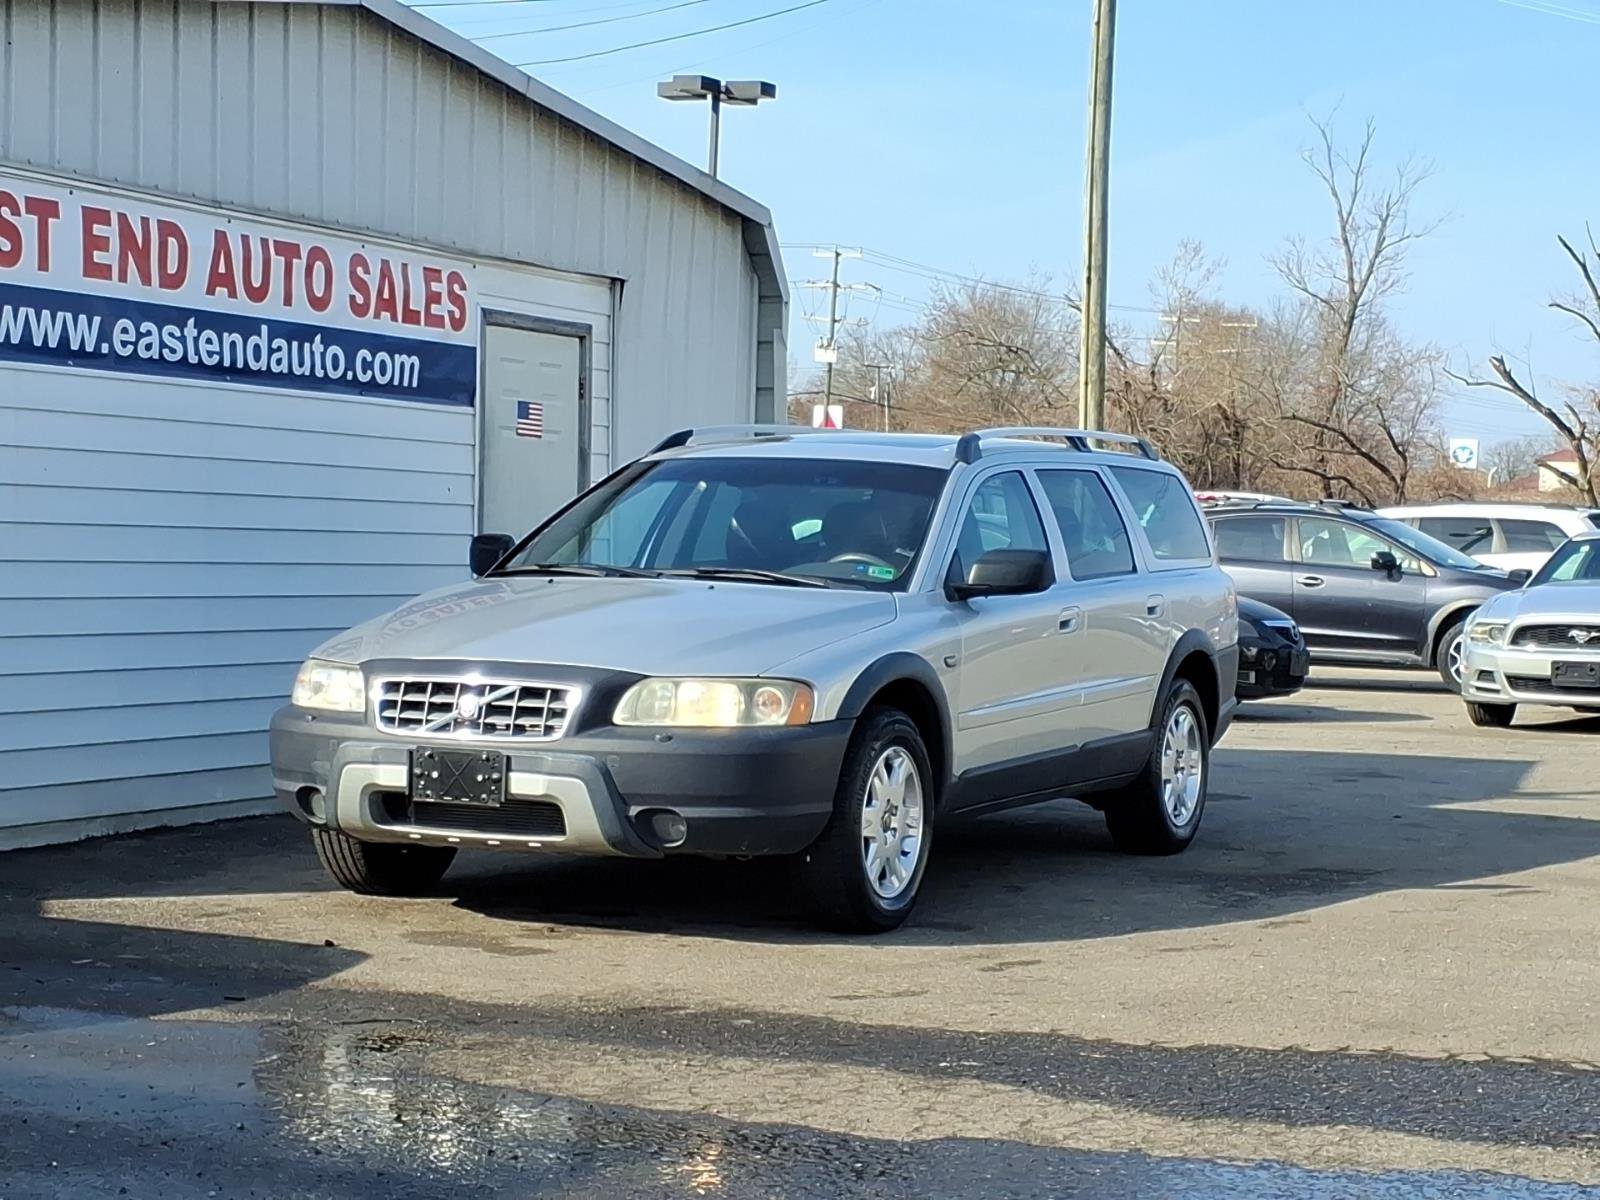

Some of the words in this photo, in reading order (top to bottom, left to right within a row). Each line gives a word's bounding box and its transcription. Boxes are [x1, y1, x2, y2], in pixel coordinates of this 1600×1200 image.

[81, 205, 189, 290] END
[205, 229, 334, 313] AUTO
[348, 252, 468, 332] SALES
[0, 304, 420, 388] www.eastendauto.com
